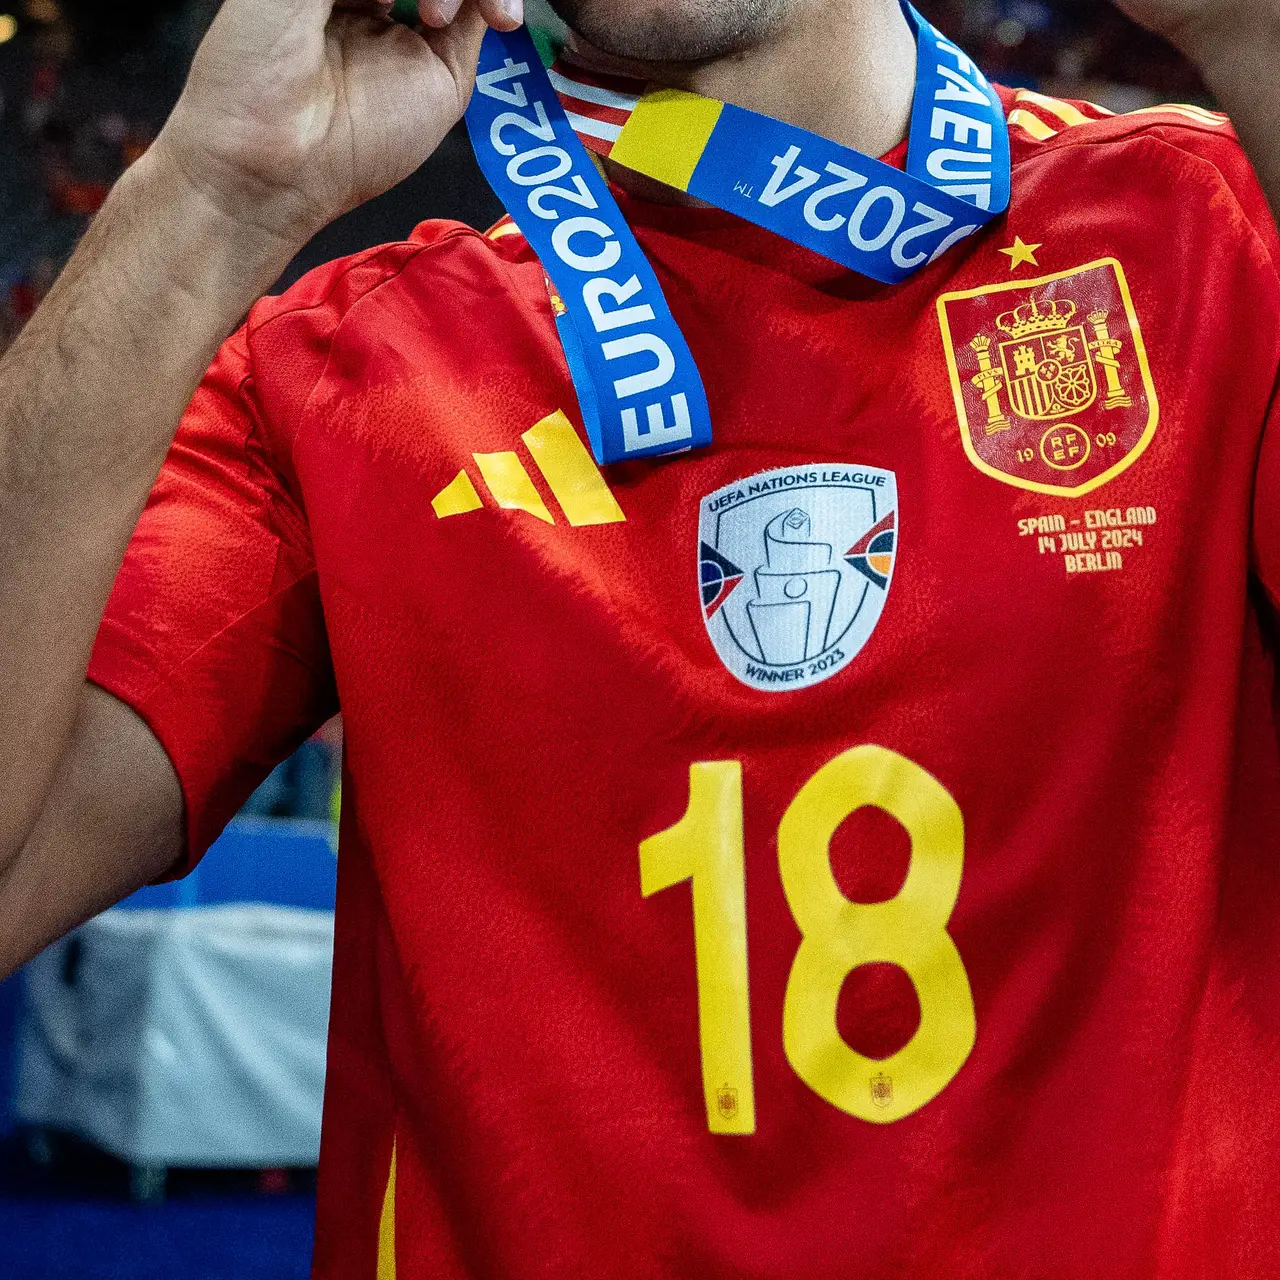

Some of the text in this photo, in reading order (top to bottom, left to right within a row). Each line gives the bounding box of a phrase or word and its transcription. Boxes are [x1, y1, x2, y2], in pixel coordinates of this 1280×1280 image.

[758, 144, 982, 269] 2024
[1017, 447, 1034, 463] 19
[1095, 432, 1117, 448] 09
[708, 471, 886, 512] UEFA NATIONS LEAGUE
[1017, 514, 1066, 536] SPAIN
[1084, 506, 1157, 529] ENGLAND
[1038, 528, 1143, 554] 14 JULY 2024
[1064, 551, 1123, 573] BERLIN
[745, 648, 845, 682] WINNER 2023
[638, 743, 977, 1136] 18
